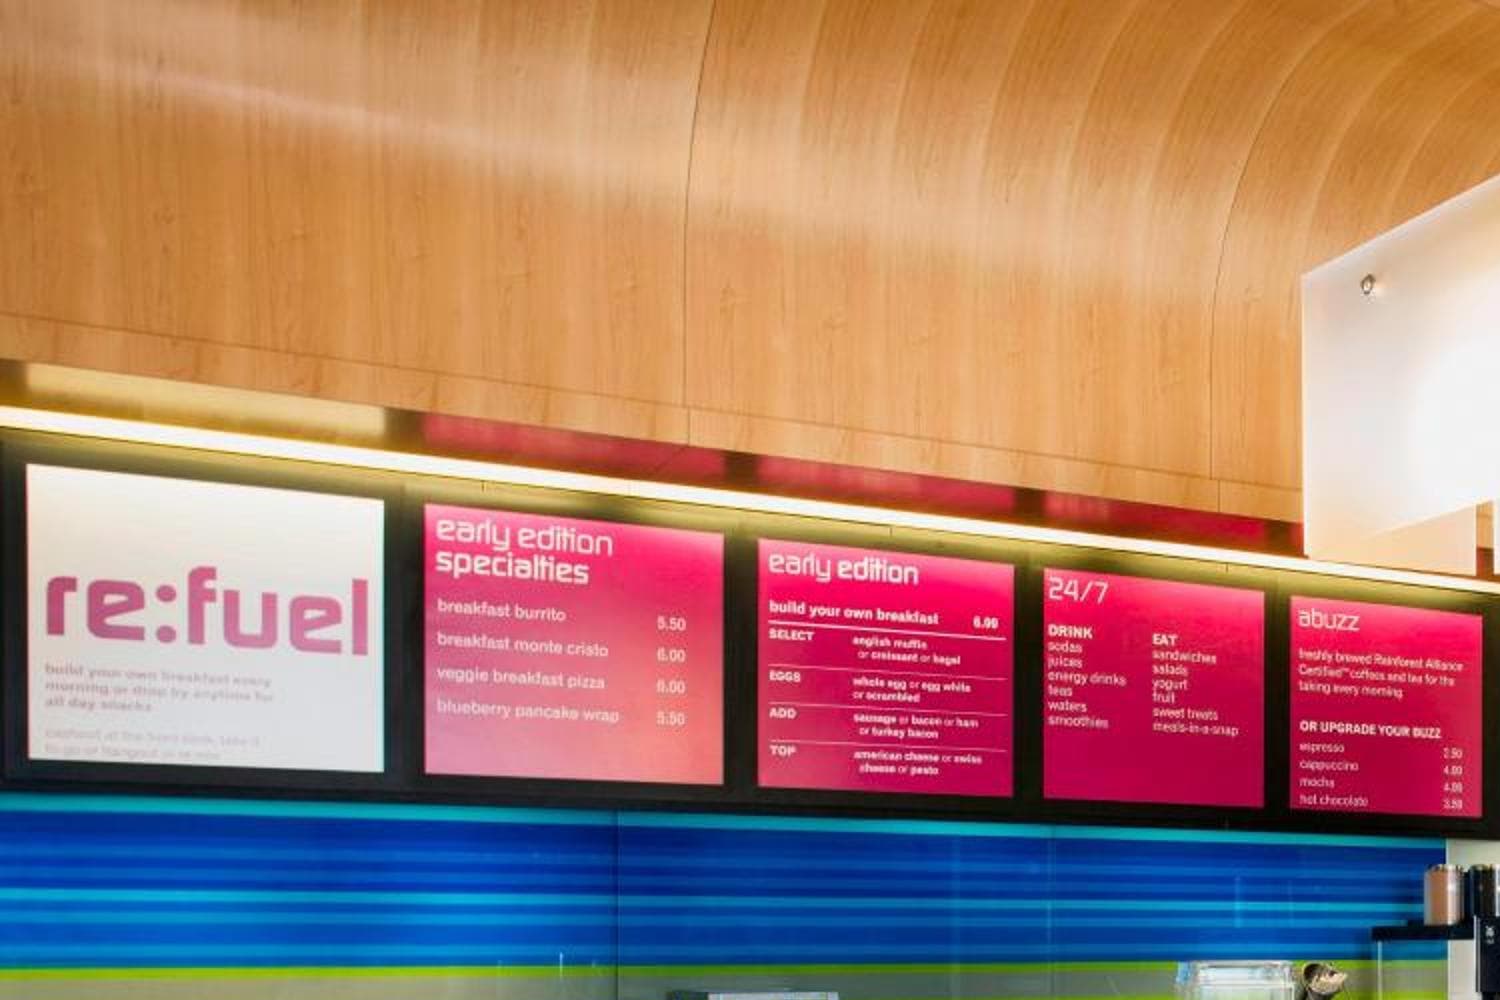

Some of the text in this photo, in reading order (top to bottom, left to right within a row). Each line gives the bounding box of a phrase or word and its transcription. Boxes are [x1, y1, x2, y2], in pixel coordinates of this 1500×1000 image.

[436, 519, 613, 556] early edition
[435, 550, 589, 584] specialties
[769, 553, 919, 586] early edition
[1049, 577, 1109, 604] 24/7
[47, 566, 368, 656] re:fuel
[438, 599, 510, 619] breakfast
[515, 603, 566, 622] burrito
[769, 600, 806, 615] build
[809, 604, 840, 619] your
[844, 607, 873, 621] own
[877, 607, 939, 625] breakfast
[1299, 608, 1360, 632] abuzz
[769, 628, 814, 641] SELECT
[1048, 623, 1093, 639] DRINK
[437, 631, 509, 650] breakfast
[514, 637, 563, 655] monte
[567, 641, 608, 657] cristo
[853, 635, 927, 650] english muffin
[1048, 640, 1083, 654] sodas
[1152, 633, 1178, 647] EAT
[871, 649, 918, 664] croissant
[933, 654, 960, 666] bagel
[1048, 655, 1083, 670] juices
[1152, 651, 1217, 665] sandwiches
[769, 670, 801, 683] EGGS
[1153, 663, 1188, 676] salads
[437, 667, 488, 683] veggie
[493, 668, 563, 688] breakfast
[567, 674, 605, 690] pizza
[853, 676, 885, 688] whole
[888, 680, 907, 691] egg
[922, 682, 940, 693] egg
[943, 682, 971, 693] white
[1048, 671, 1127, 687] energy drinks
[1153, 679, 1187, 691] yogurt
[866, 690, 920, 703] scrambled
[1048, 685, 1073, 697] teas
[1153, 691, 1176, 704] fruit
[437, 699, 510, 719] blueberry
[515, 703, 578, 722] pancake
[583, 708, 619, 724] wrap
[1048, 700, 1087, 713] waters
[769, 708, 796, 720] ADD
[853, 714, 896, 725] sausage
[911, 714, 942, 727] bacon
[1153, 707, 1218, 721] sweet treats
[1048, 715, 1109, 729] smoothies
[872, 726, 905, 739] turkey
[908, 728, 938, 740] bacon
[1300, 720, 1442, 739] OR UPGRADE YOUR BUZZ
[769, 745, 796, 757] TOP
[854, 749, 902, 761] american
[1299, 759, 1359, 772] cappuccino
[1299, 776, 1335, 788] mocha
[1299, 794, 1317, 805] hot
[1320, 794, 1368, 808] chocolate
